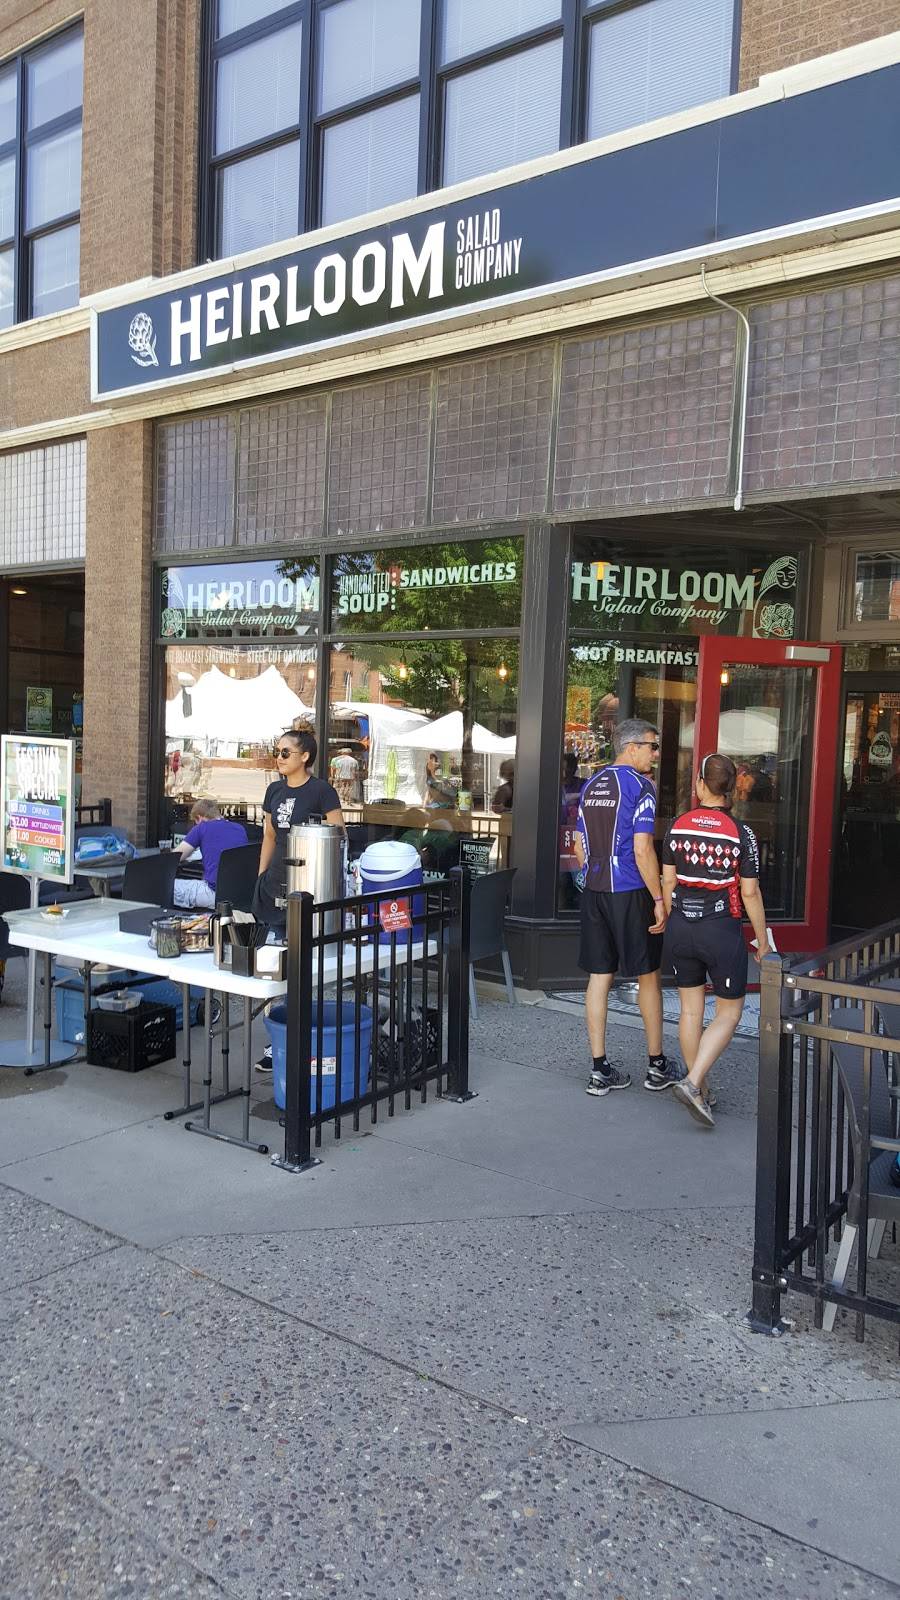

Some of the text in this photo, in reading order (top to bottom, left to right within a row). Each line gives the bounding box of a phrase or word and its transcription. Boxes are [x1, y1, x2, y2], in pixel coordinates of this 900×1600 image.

[457, 208, 500, 254] SALAD
[456, 237, 522, 289] COMPANY
[170, 221, 446, 366] HEIRLOOM
[341, 573, 389, 595] HANDCRAFTED
[400, 562, 517, 587] SANDWICHES
[572, 562, 755, 610] HEIRLOOM
[187, 577, 320, 617] HEIRLOOM
[339, 593, 389, 614] SOUP
[201, 609, 299, 631] Salad Company
[593, 597, 729, 624] Salad Company
[247, 650, 266, 664] STEEL
[268, 650, 281, 664] CUT
[577, 646, 699, 666] HOT BREAKFAST
[17, 771, 61, 800] SPECIAL
[465, 854, 488, 863] HOURS
